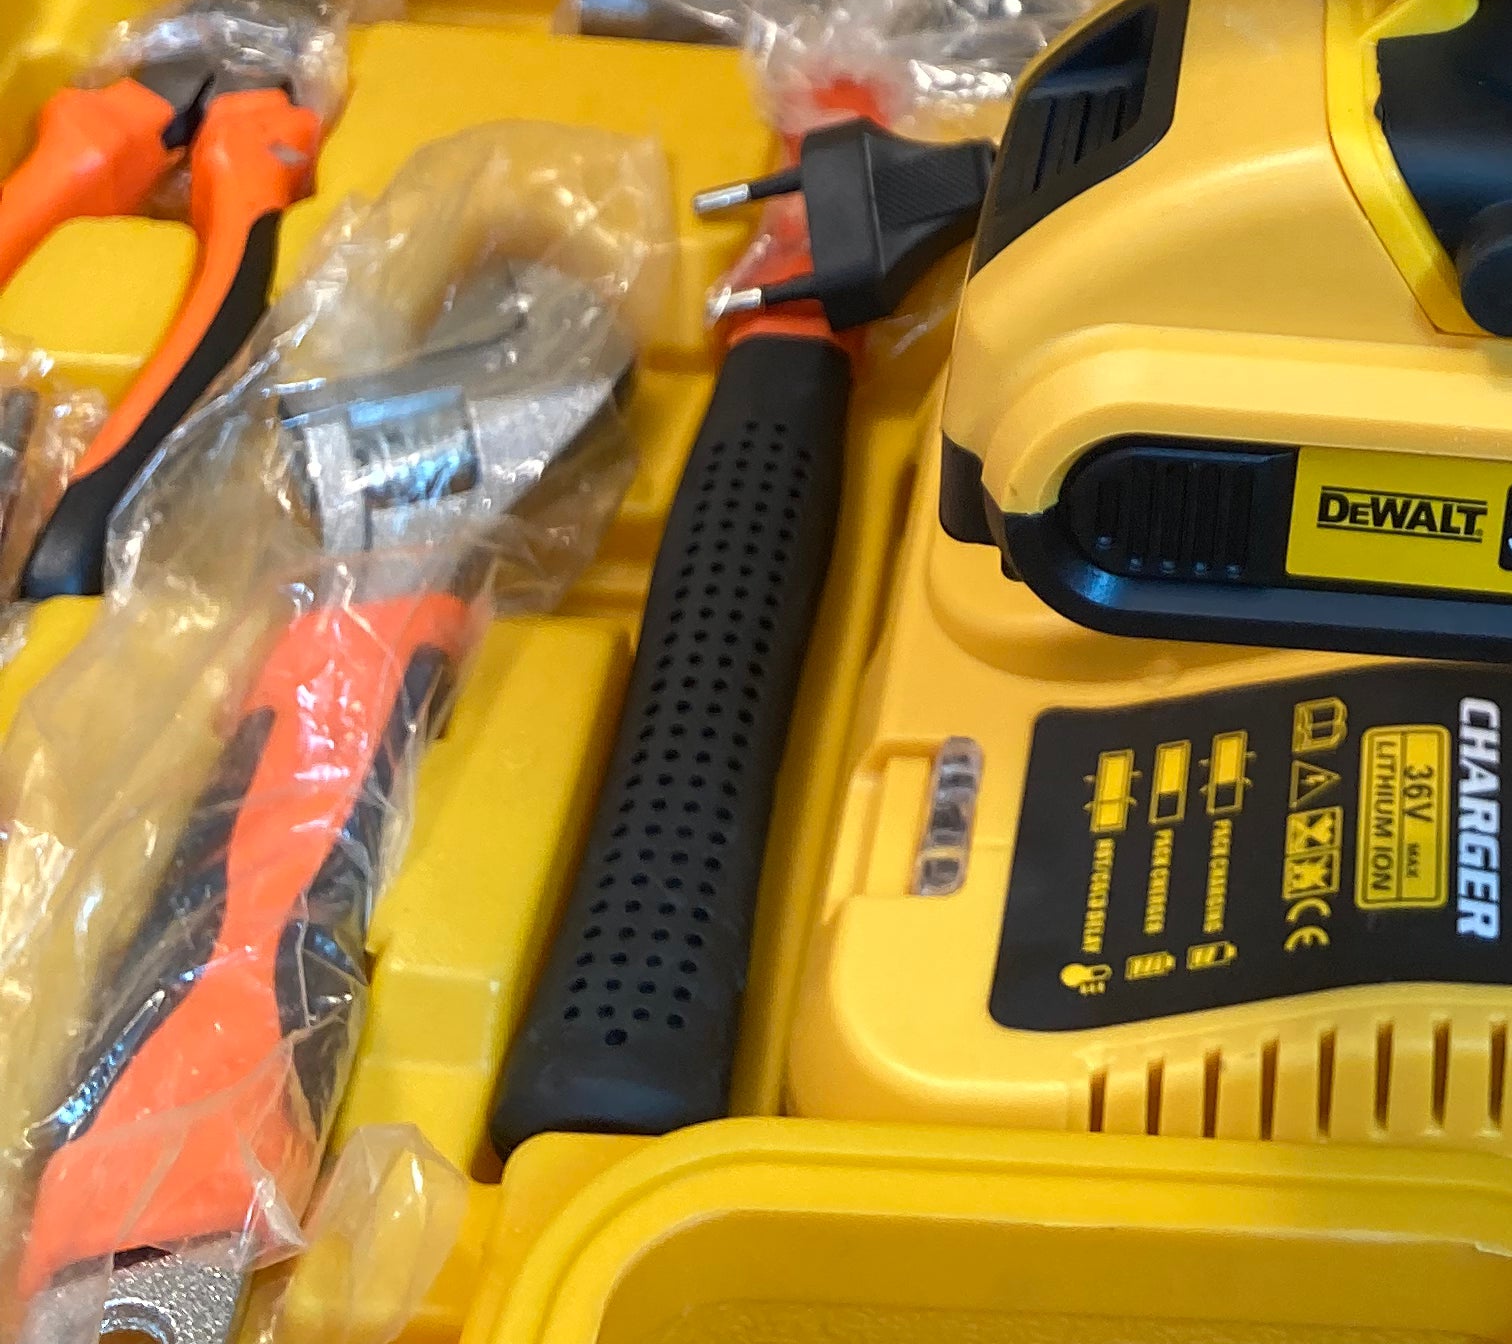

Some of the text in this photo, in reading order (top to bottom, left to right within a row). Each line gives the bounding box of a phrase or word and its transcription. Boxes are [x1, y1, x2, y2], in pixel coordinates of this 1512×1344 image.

[1371, 740, 1397, 892] LITHIUM ION
[1403, 765, 1434, 823] 36V
[1456, 696, 1500, 940] CHARGER
